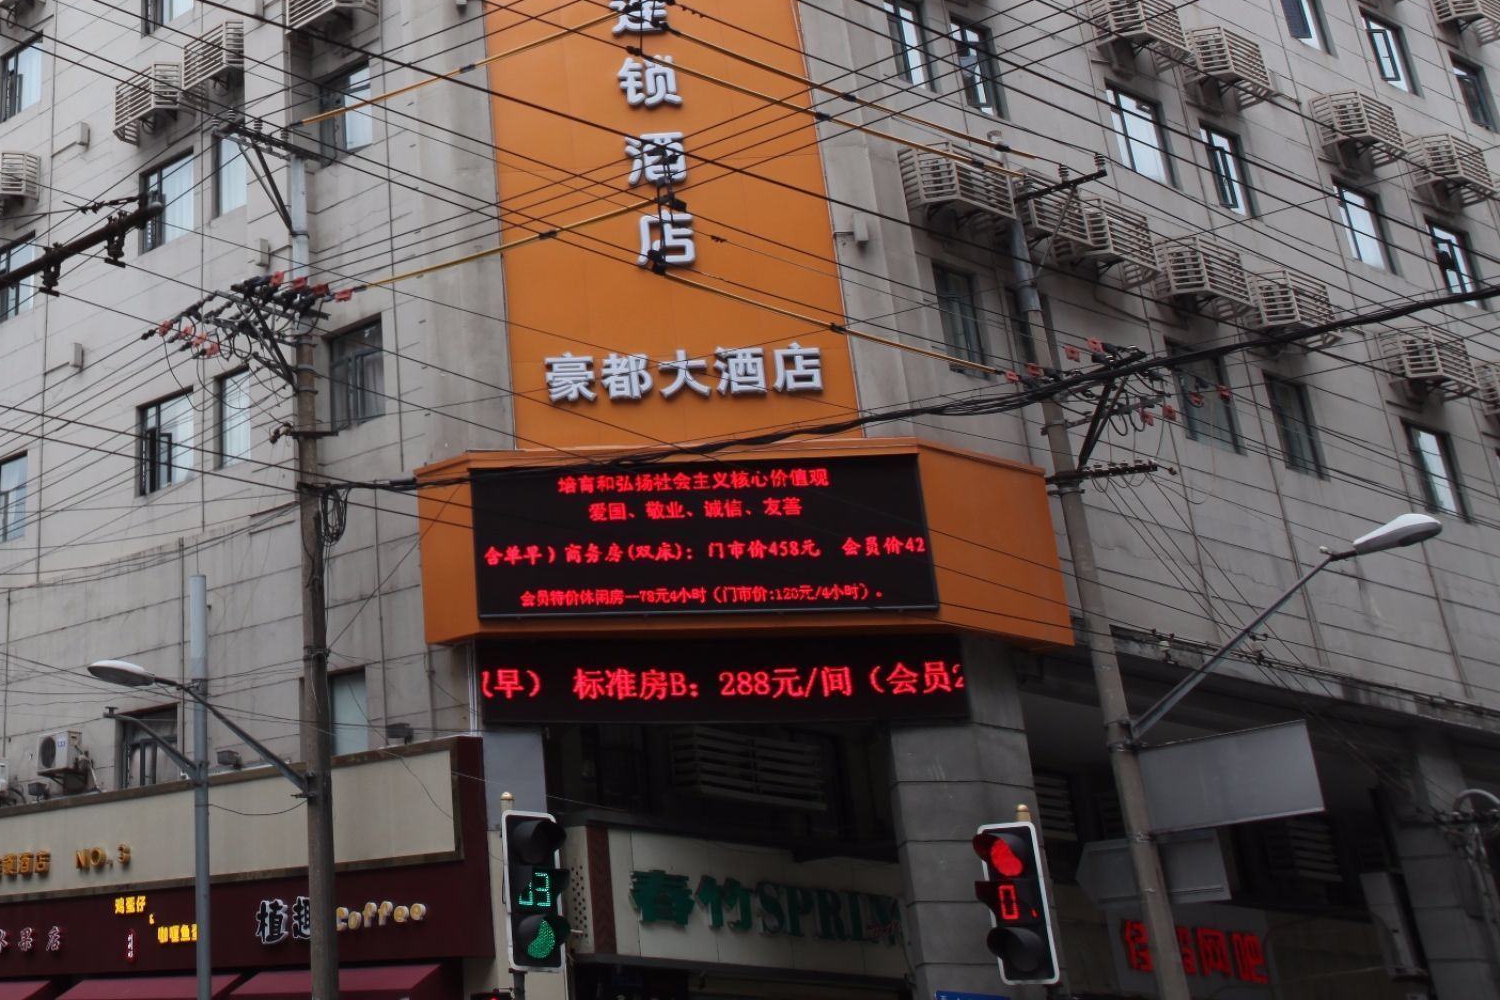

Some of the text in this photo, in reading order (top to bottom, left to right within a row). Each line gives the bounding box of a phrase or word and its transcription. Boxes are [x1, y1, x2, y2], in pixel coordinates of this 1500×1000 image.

[544, 342, 823, 402] 豪都大酒店
[557, 468, 830, 495] 培育和弘扬社会主义核心价值观
[588, 496, 803, 522] 爱国、敬业、诚信、友善
[629, 869, 753, 930] 春竹
